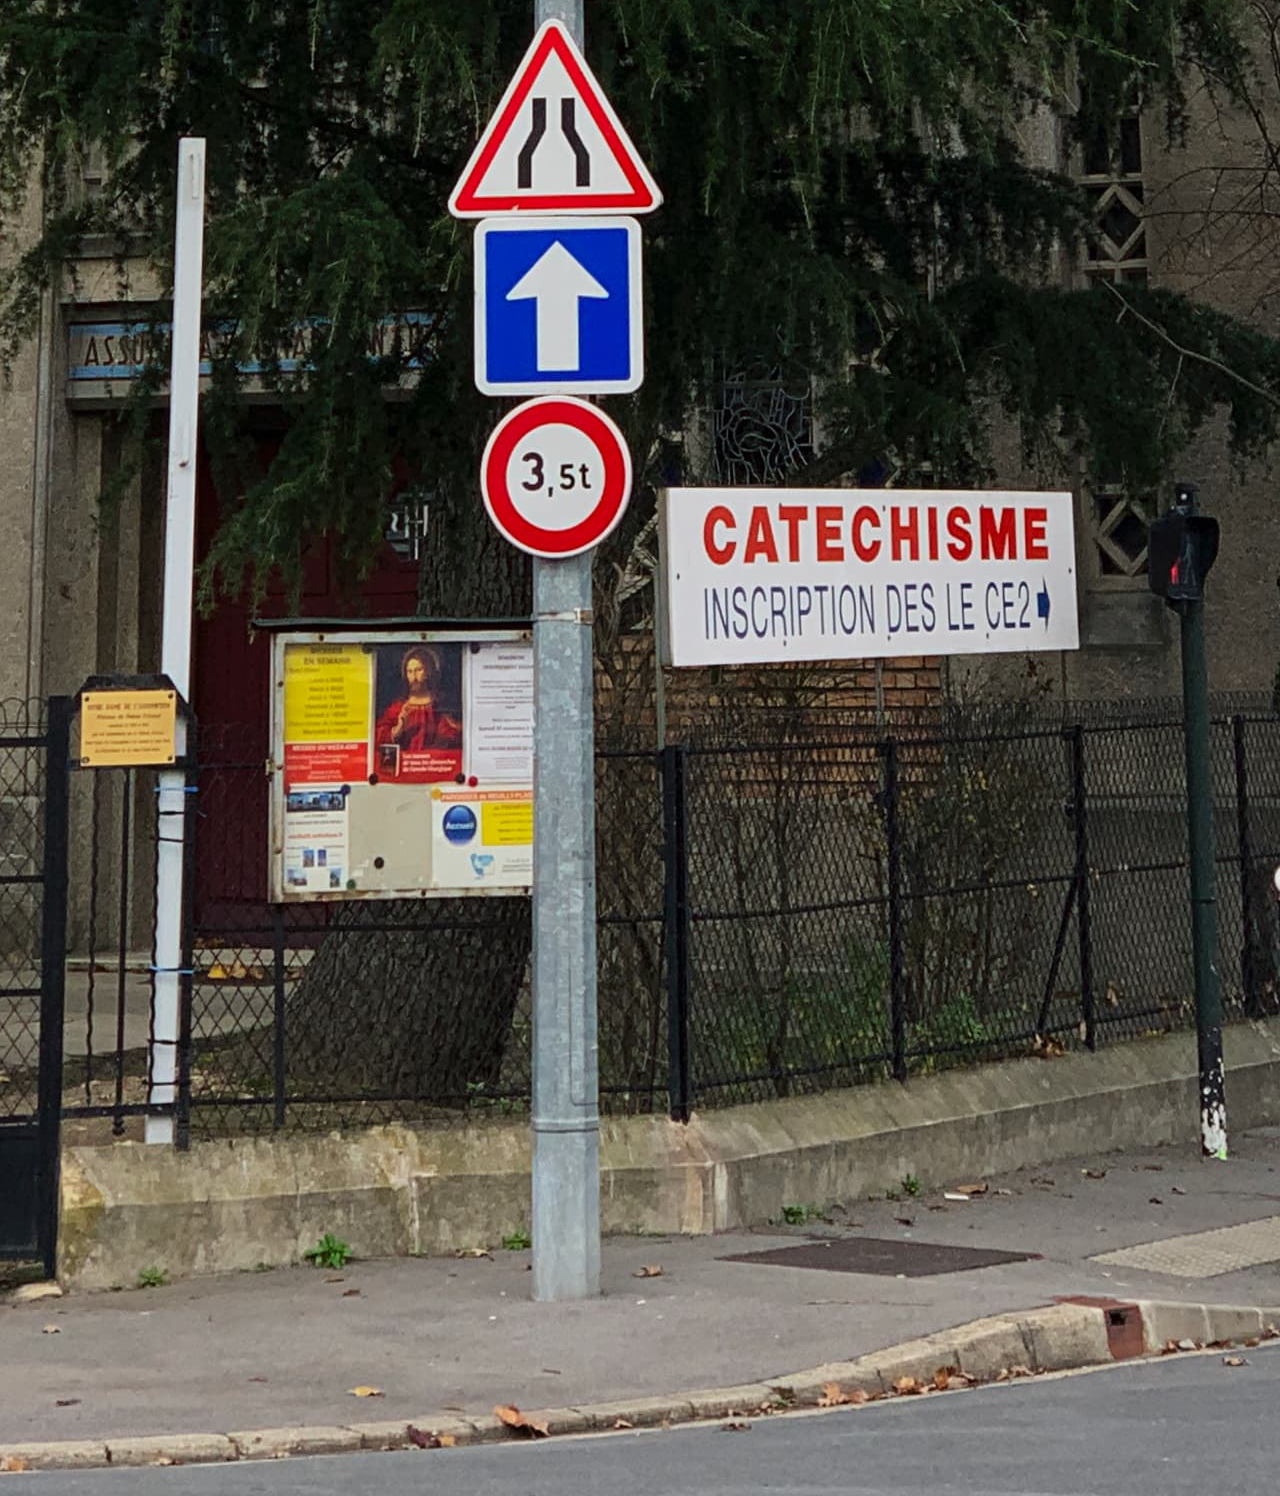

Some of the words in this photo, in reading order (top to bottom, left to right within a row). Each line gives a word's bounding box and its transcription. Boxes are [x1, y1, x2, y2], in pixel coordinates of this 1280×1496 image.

[521, 451, 592, 498] 3,5t
[703, 505, 1050, 566] CATECHISME
[704, 583, 876, 640] INSCRIPTION
[887, 582, 937, 633] DES
[946, 582, 975, 631] LE
[985, 580, 1031, 631] CE2
